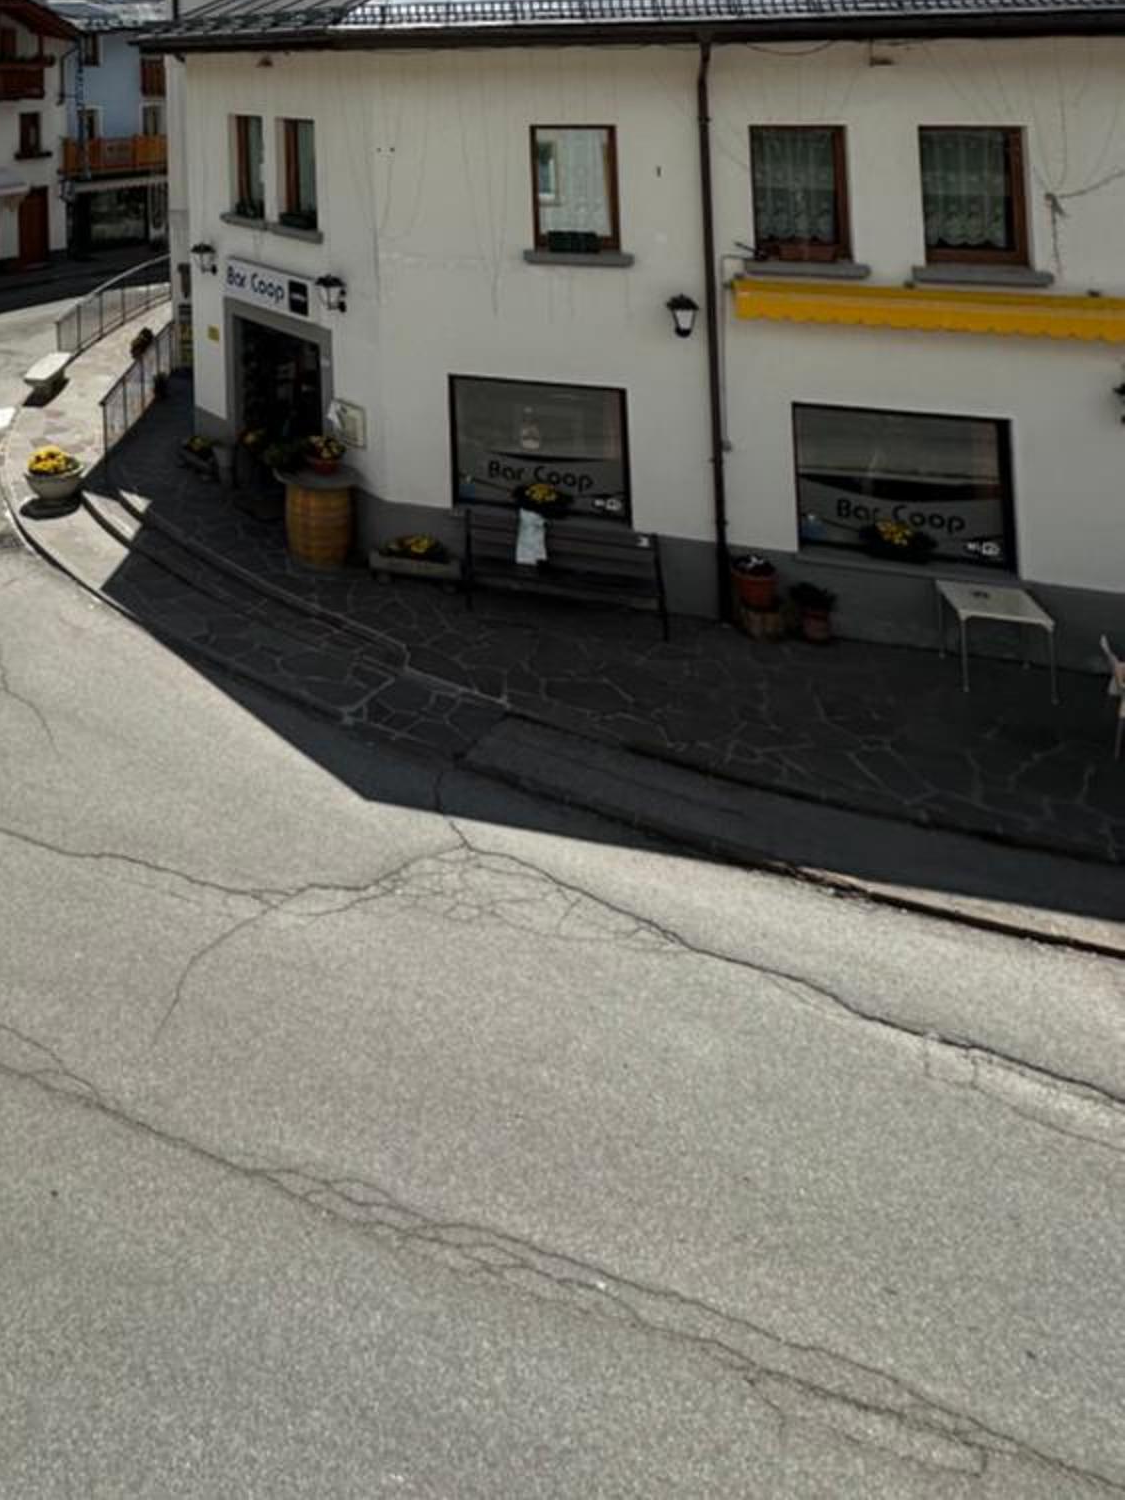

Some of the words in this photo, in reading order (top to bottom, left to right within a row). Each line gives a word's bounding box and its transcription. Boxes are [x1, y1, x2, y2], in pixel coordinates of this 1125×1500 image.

[226, 265, 245, 288] Bar
[250, 272, 285, 304] Coop
[487, 460, 525, 480] Bar
[533, 465, 593, 492] Coop
[836, 498, 881, 521] Bar
[891, 504, 965, 533] Coop
